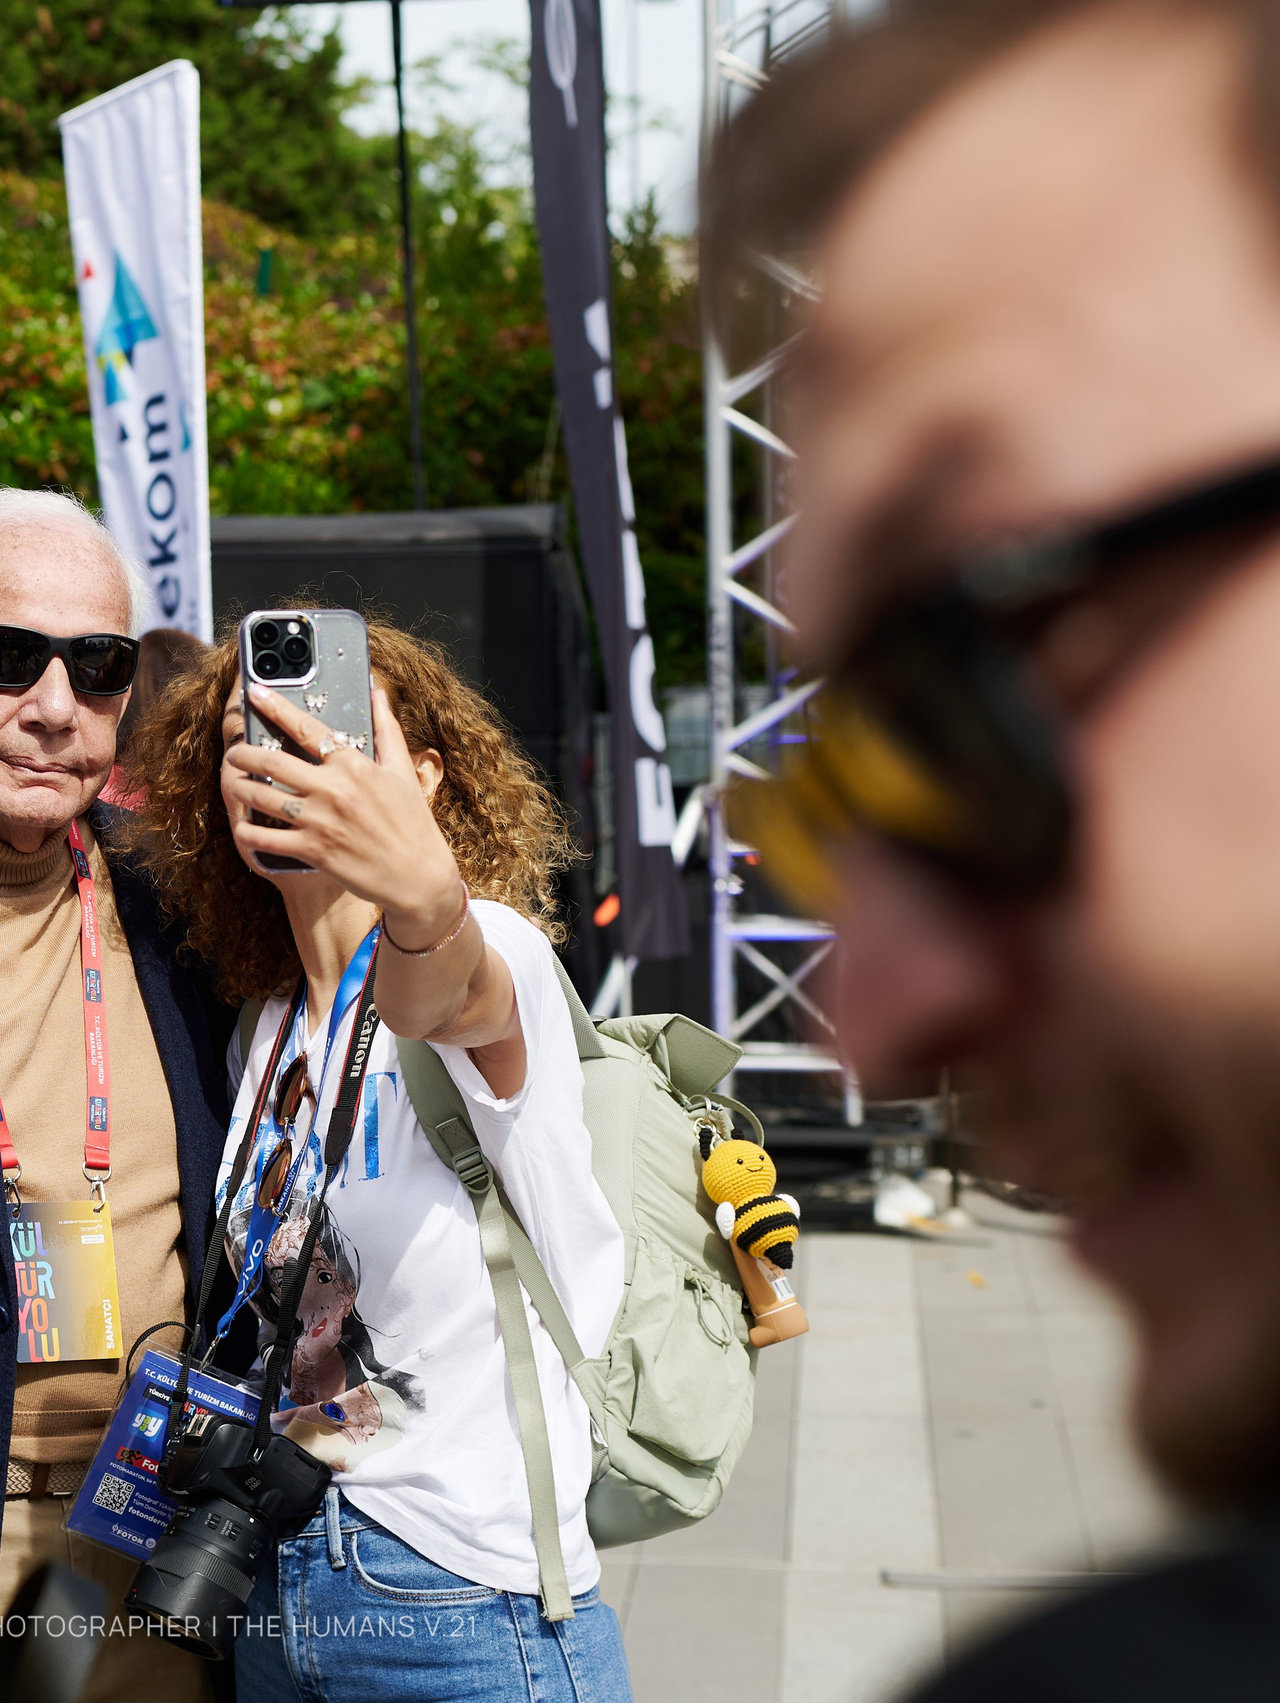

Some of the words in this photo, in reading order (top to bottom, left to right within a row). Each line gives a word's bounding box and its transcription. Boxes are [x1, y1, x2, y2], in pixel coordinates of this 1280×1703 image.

[145, 394, 181, 618] ekom
[90, 1032, 98, 1066] BAKANLIĞI
[97, 1051, 103, 1059] VE
[350, 1003, 378, 1077] Canon
[97, 1060, 105, 1084] TURİZM
[18, 1298, 49, 1334] YO
[103, 1299, 115, 1349] SANATÇI
[28, 1328, 60, 1362] LU
[145, 1368, 157, 1379] T.C.
[156, 1373, 180, 1389] KÜLTÜ
[194, 1389, 220, 1405] TURİZM
[219, 1401, 256, 1421] BAKANLIĞI
[142, 1459, 160, 1473] Fot
[133, 1498, 144, 1507] Tüm
[144, 1502, 167, 1518] Detaylar
[134, 1492, 158, 1506] Fotoğraf
[158, 1501, 176, 1513] Yüklen
[116, 1530, 143, 1545] FOTON
